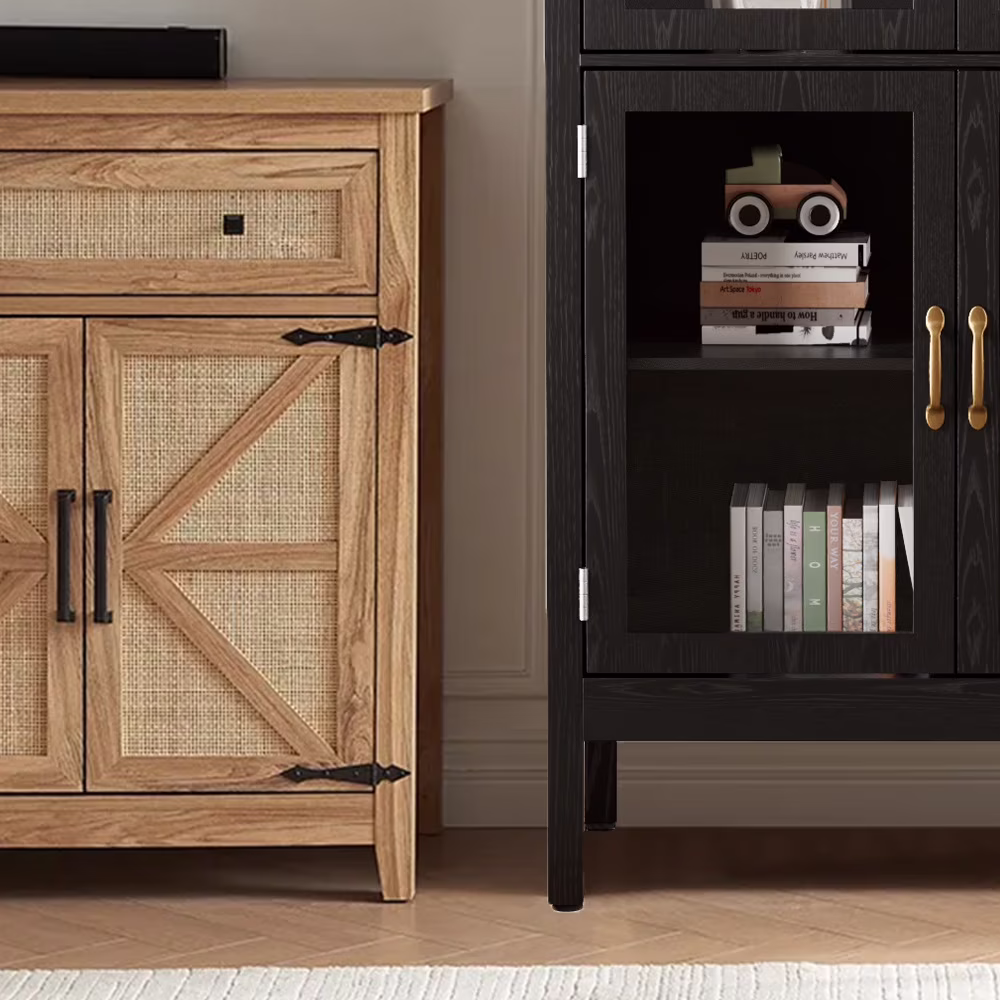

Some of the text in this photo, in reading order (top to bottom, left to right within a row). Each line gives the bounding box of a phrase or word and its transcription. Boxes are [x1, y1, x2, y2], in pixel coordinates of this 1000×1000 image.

[740, 252, 767, 260] POETRY
[794, 250, 848, 260] Matthew Parsley
[745, 285, 762, 293] Tokyo
[750, 311, 755, 319] a
[757, 310, 785, 321] handle
[787, 312, 796, 321] to
[800, 311, 818, 321] How
[830, 512, 839, 570] YOUR WAY
